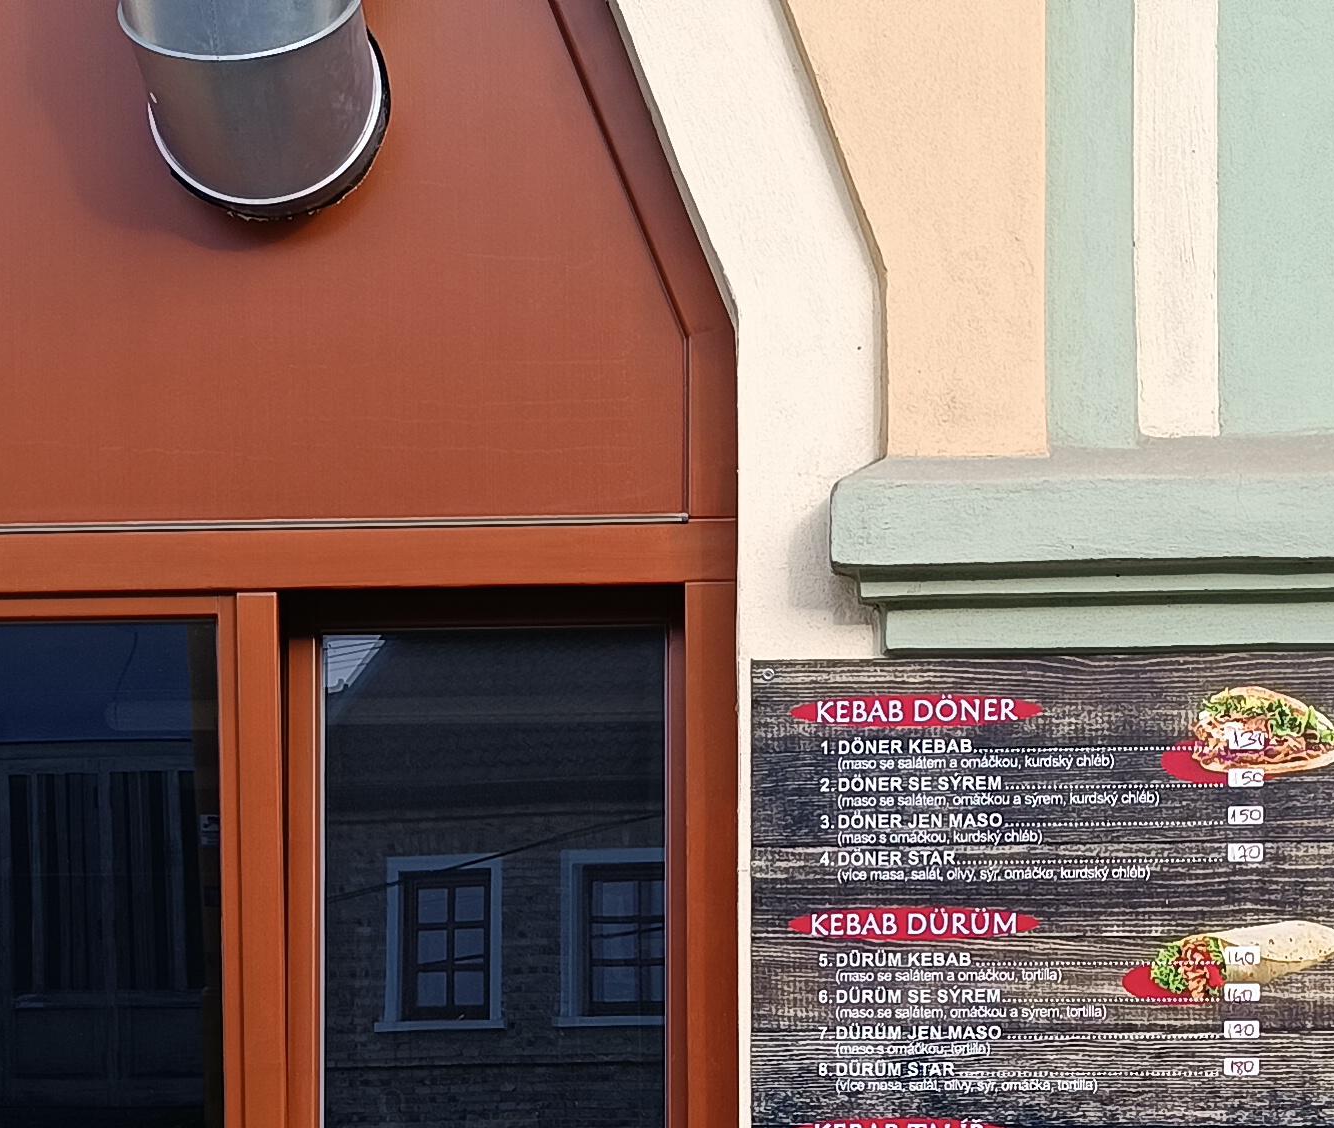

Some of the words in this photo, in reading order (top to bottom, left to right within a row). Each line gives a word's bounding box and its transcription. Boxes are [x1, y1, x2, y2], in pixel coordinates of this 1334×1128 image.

[817, 701, 904, 723] KEBAB
[914, 694, 1018, 722] DÖNER
[821, 741, 835, 754] 1.
[838, 739, 903, 754] DÖNER
[909, 739, 972, 754] KEBAB
[820, 778, 836, 792] 2.
[838, 775, 903, 791] DÖNER
[908, 777, 932, 791] SE
[938, 772, 1002, 791] SÝREM
[811, 913, 897, 936] KEBAB
[908, 908, 1017, 935] DÜRÜM
[819, 953, 833, 967] 5.
[836, 950, 901, 967] DÜRÜM
[907, 952, 971, 967] KEBAB
